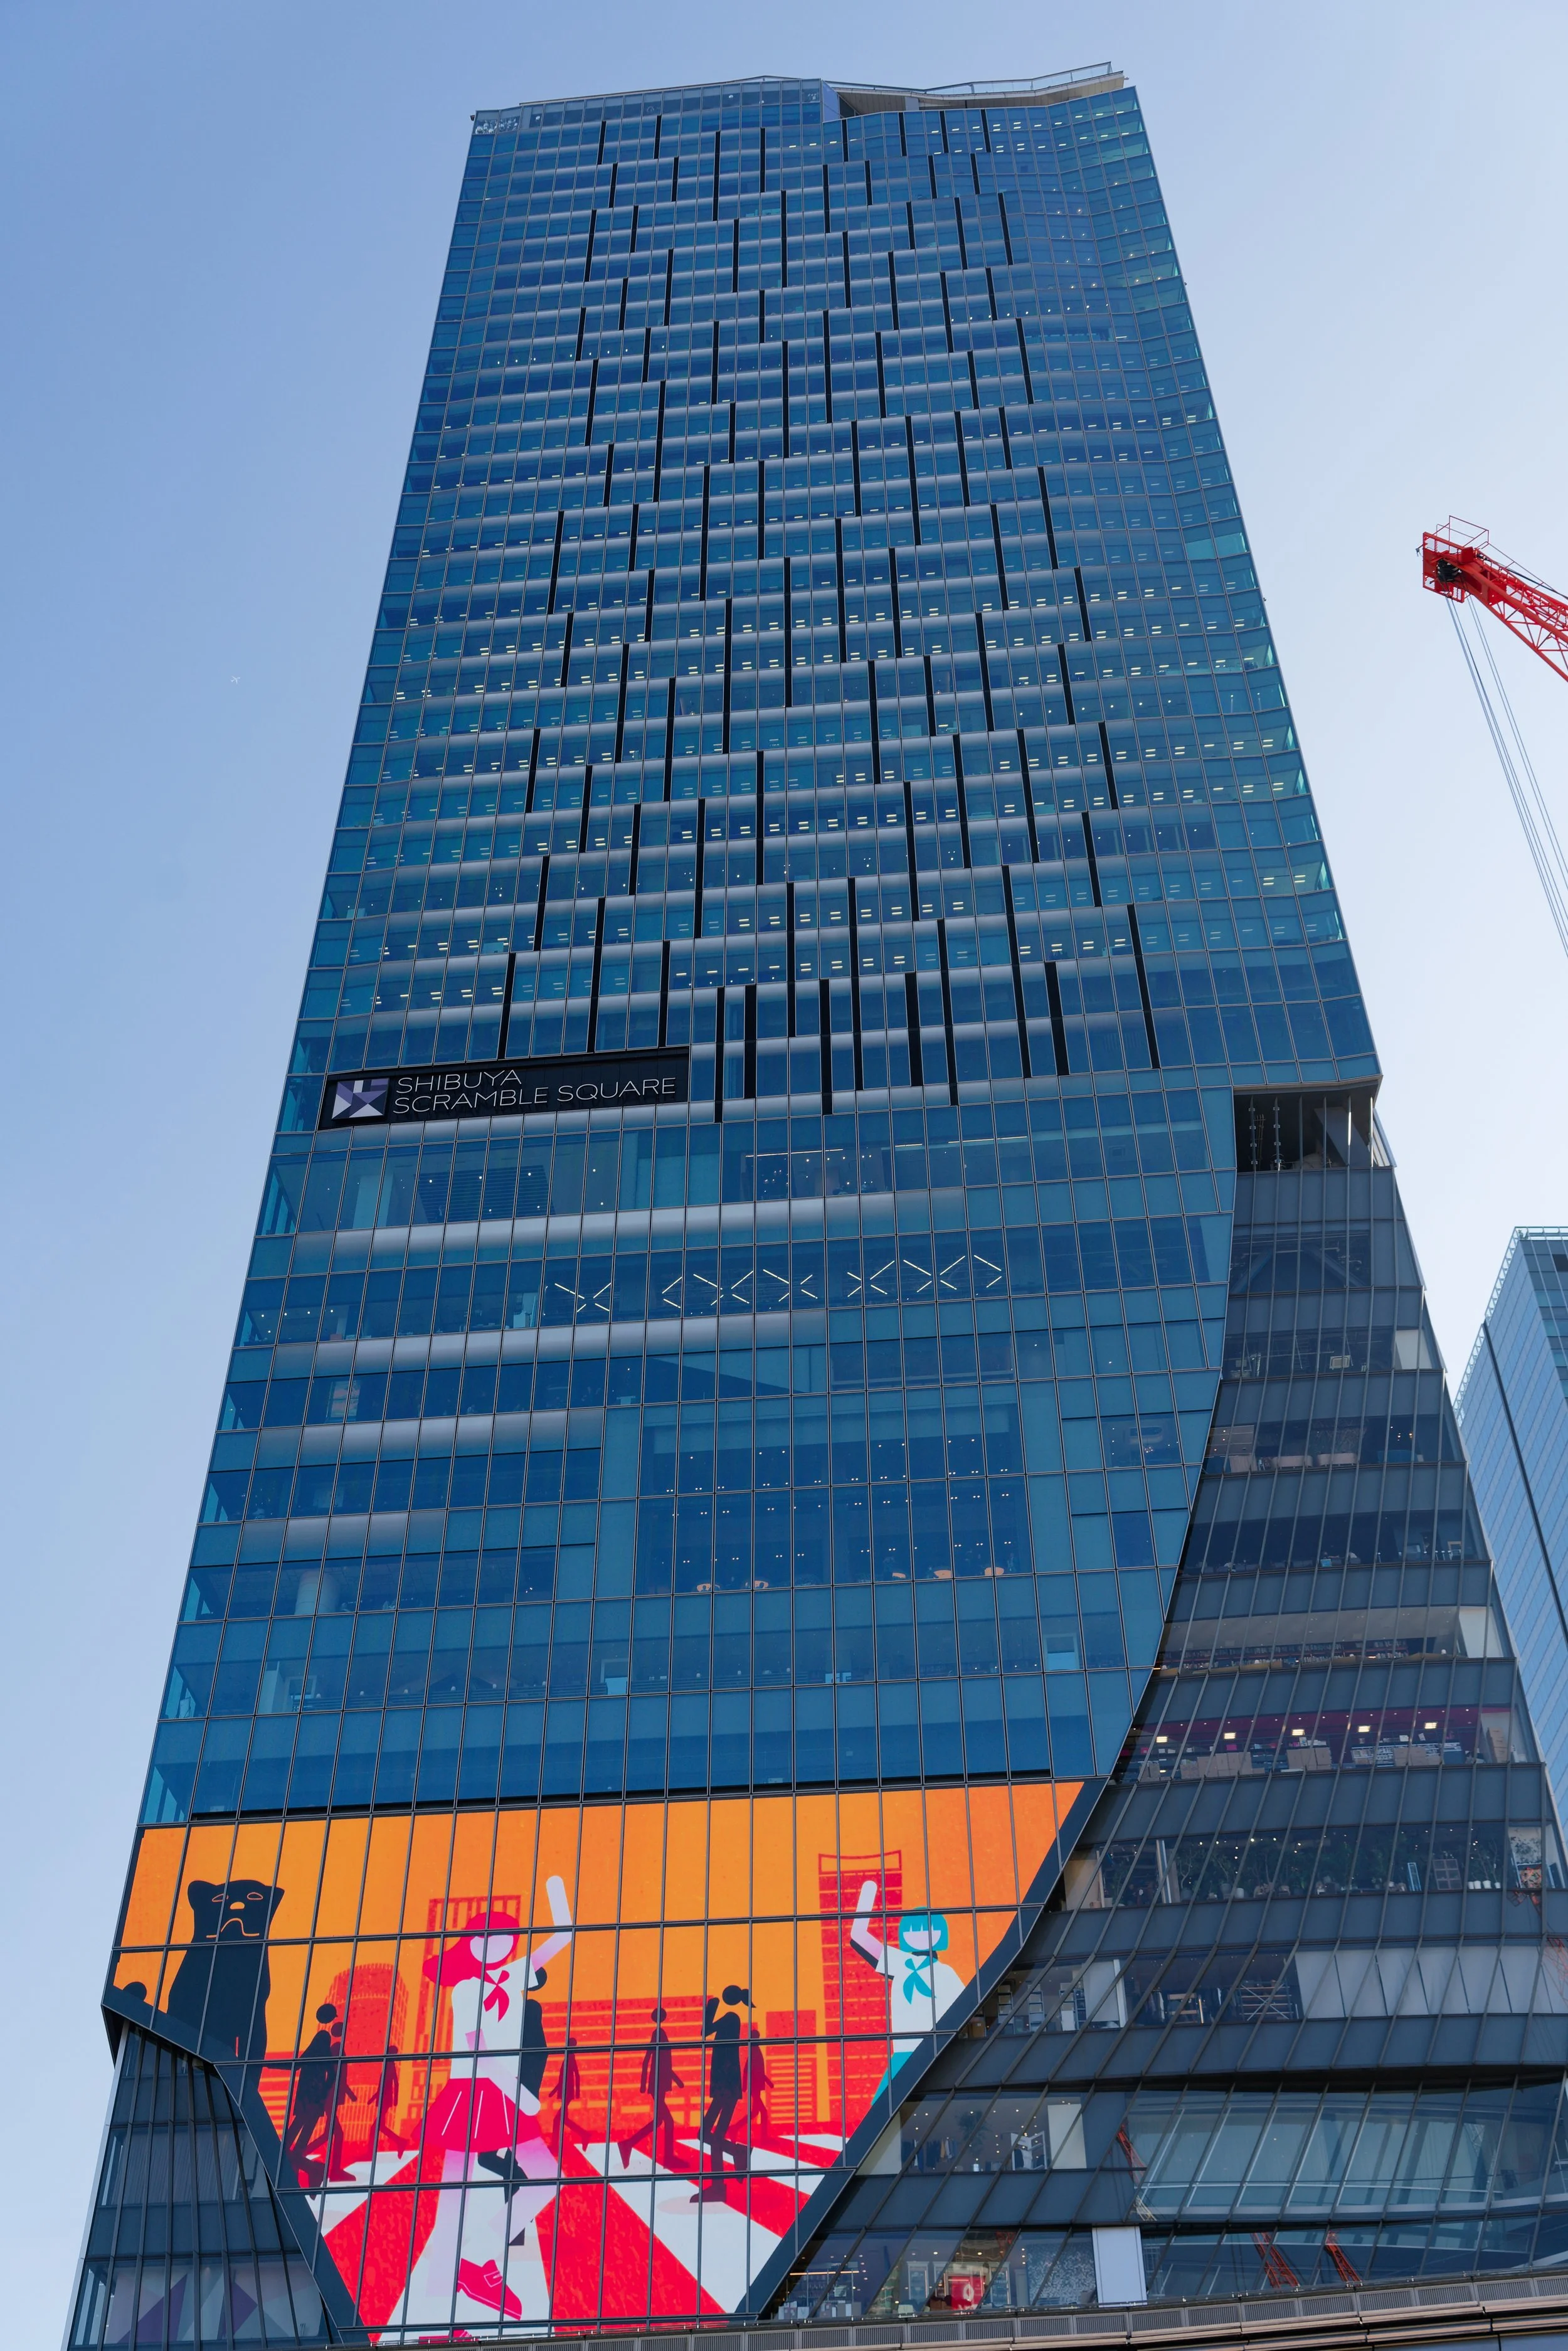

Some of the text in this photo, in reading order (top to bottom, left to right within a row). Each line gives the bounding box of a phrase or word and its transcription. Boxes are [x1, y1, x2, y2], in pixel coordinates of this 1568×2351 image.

[393, 1077, 676, 1114] SCRAMBLE SQUARE
[396, 1069, 522, 1093] SHIBUYA
